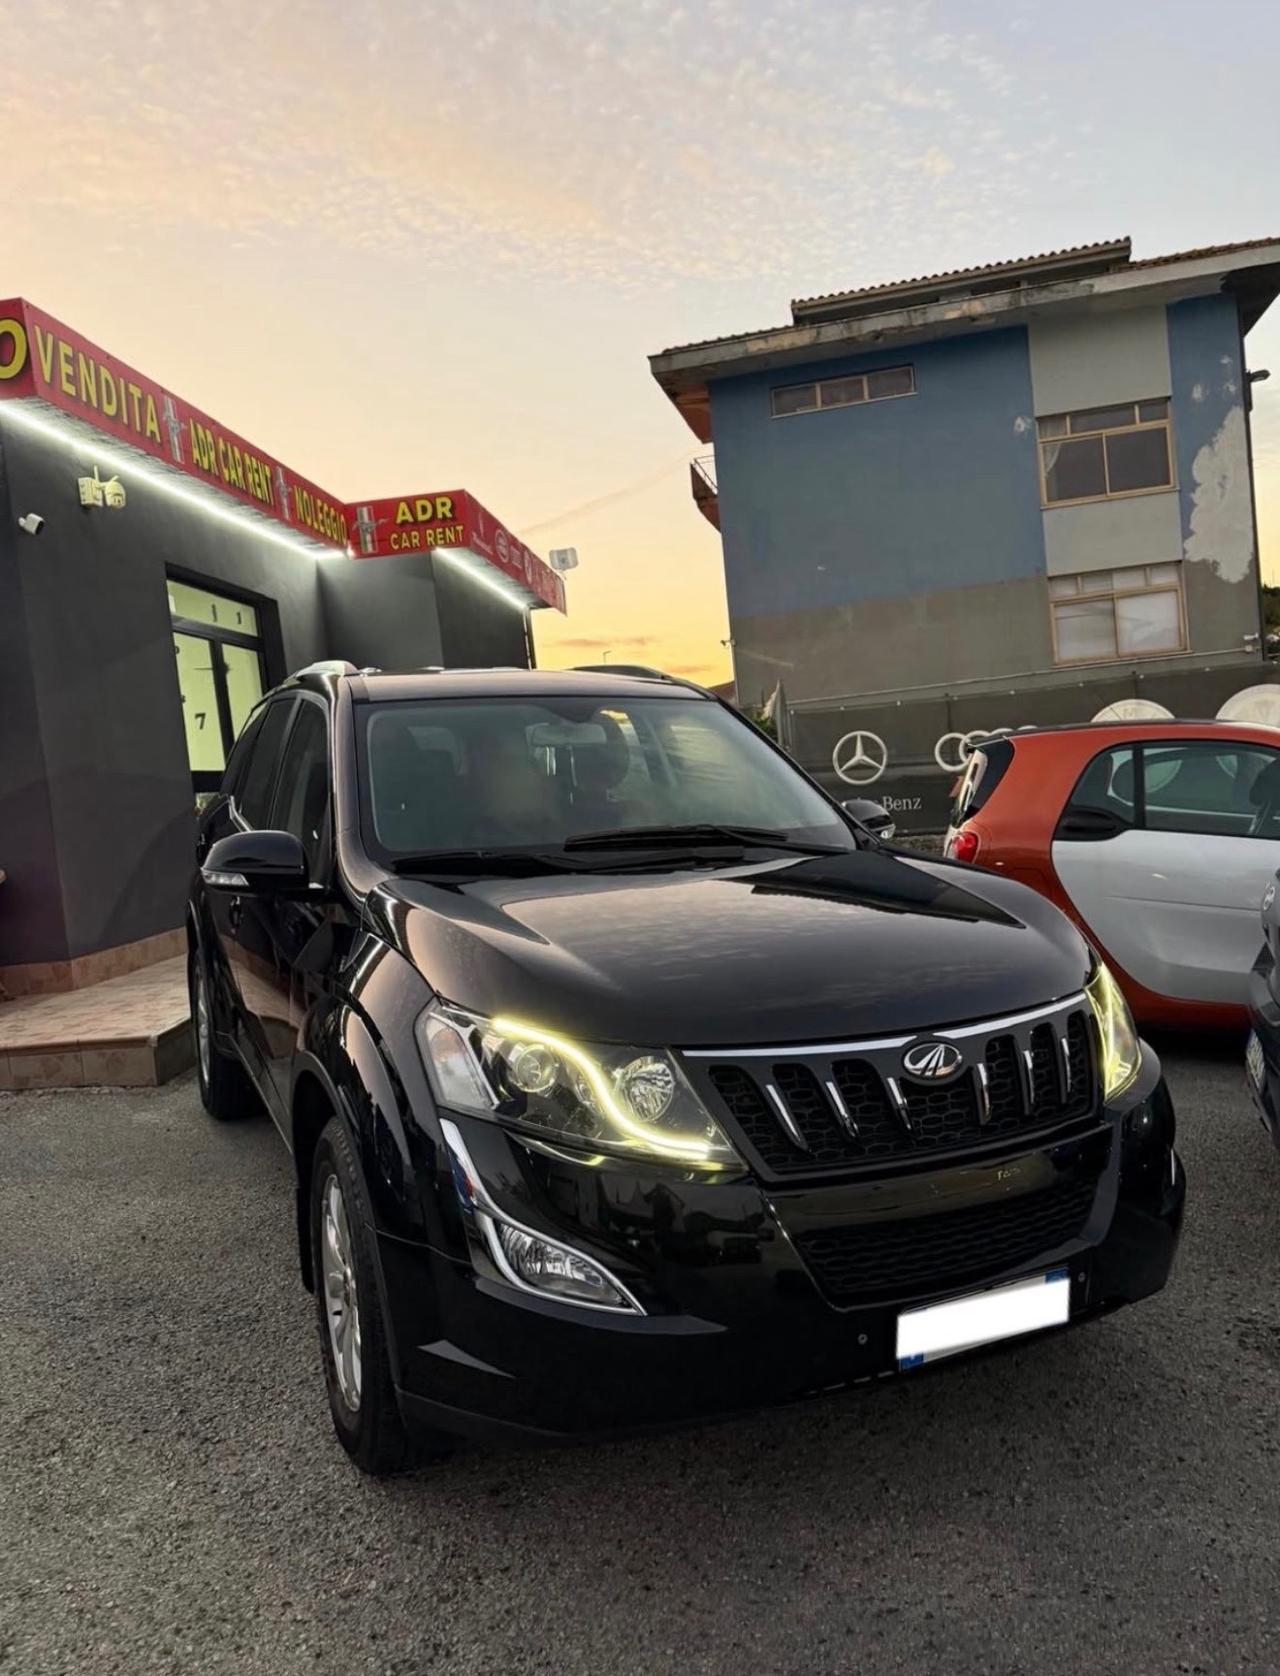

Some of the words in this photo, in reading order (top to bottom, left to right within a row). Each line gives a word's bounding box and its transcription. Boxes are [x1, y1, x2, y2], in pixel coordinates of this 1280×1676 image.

[34, 325, 161, 444] VENDITA
[189, 417, 219, 476] ADR
[219, 436, 246, 490] CAR
[243, 452, 274, 506] RENT
[294, 485, 347, 545] NOLEGGIO
[390, 530, 420, 550] CAR
[425, 525, 464, 546] RENT
[396, 496, 452, 524] ADR
